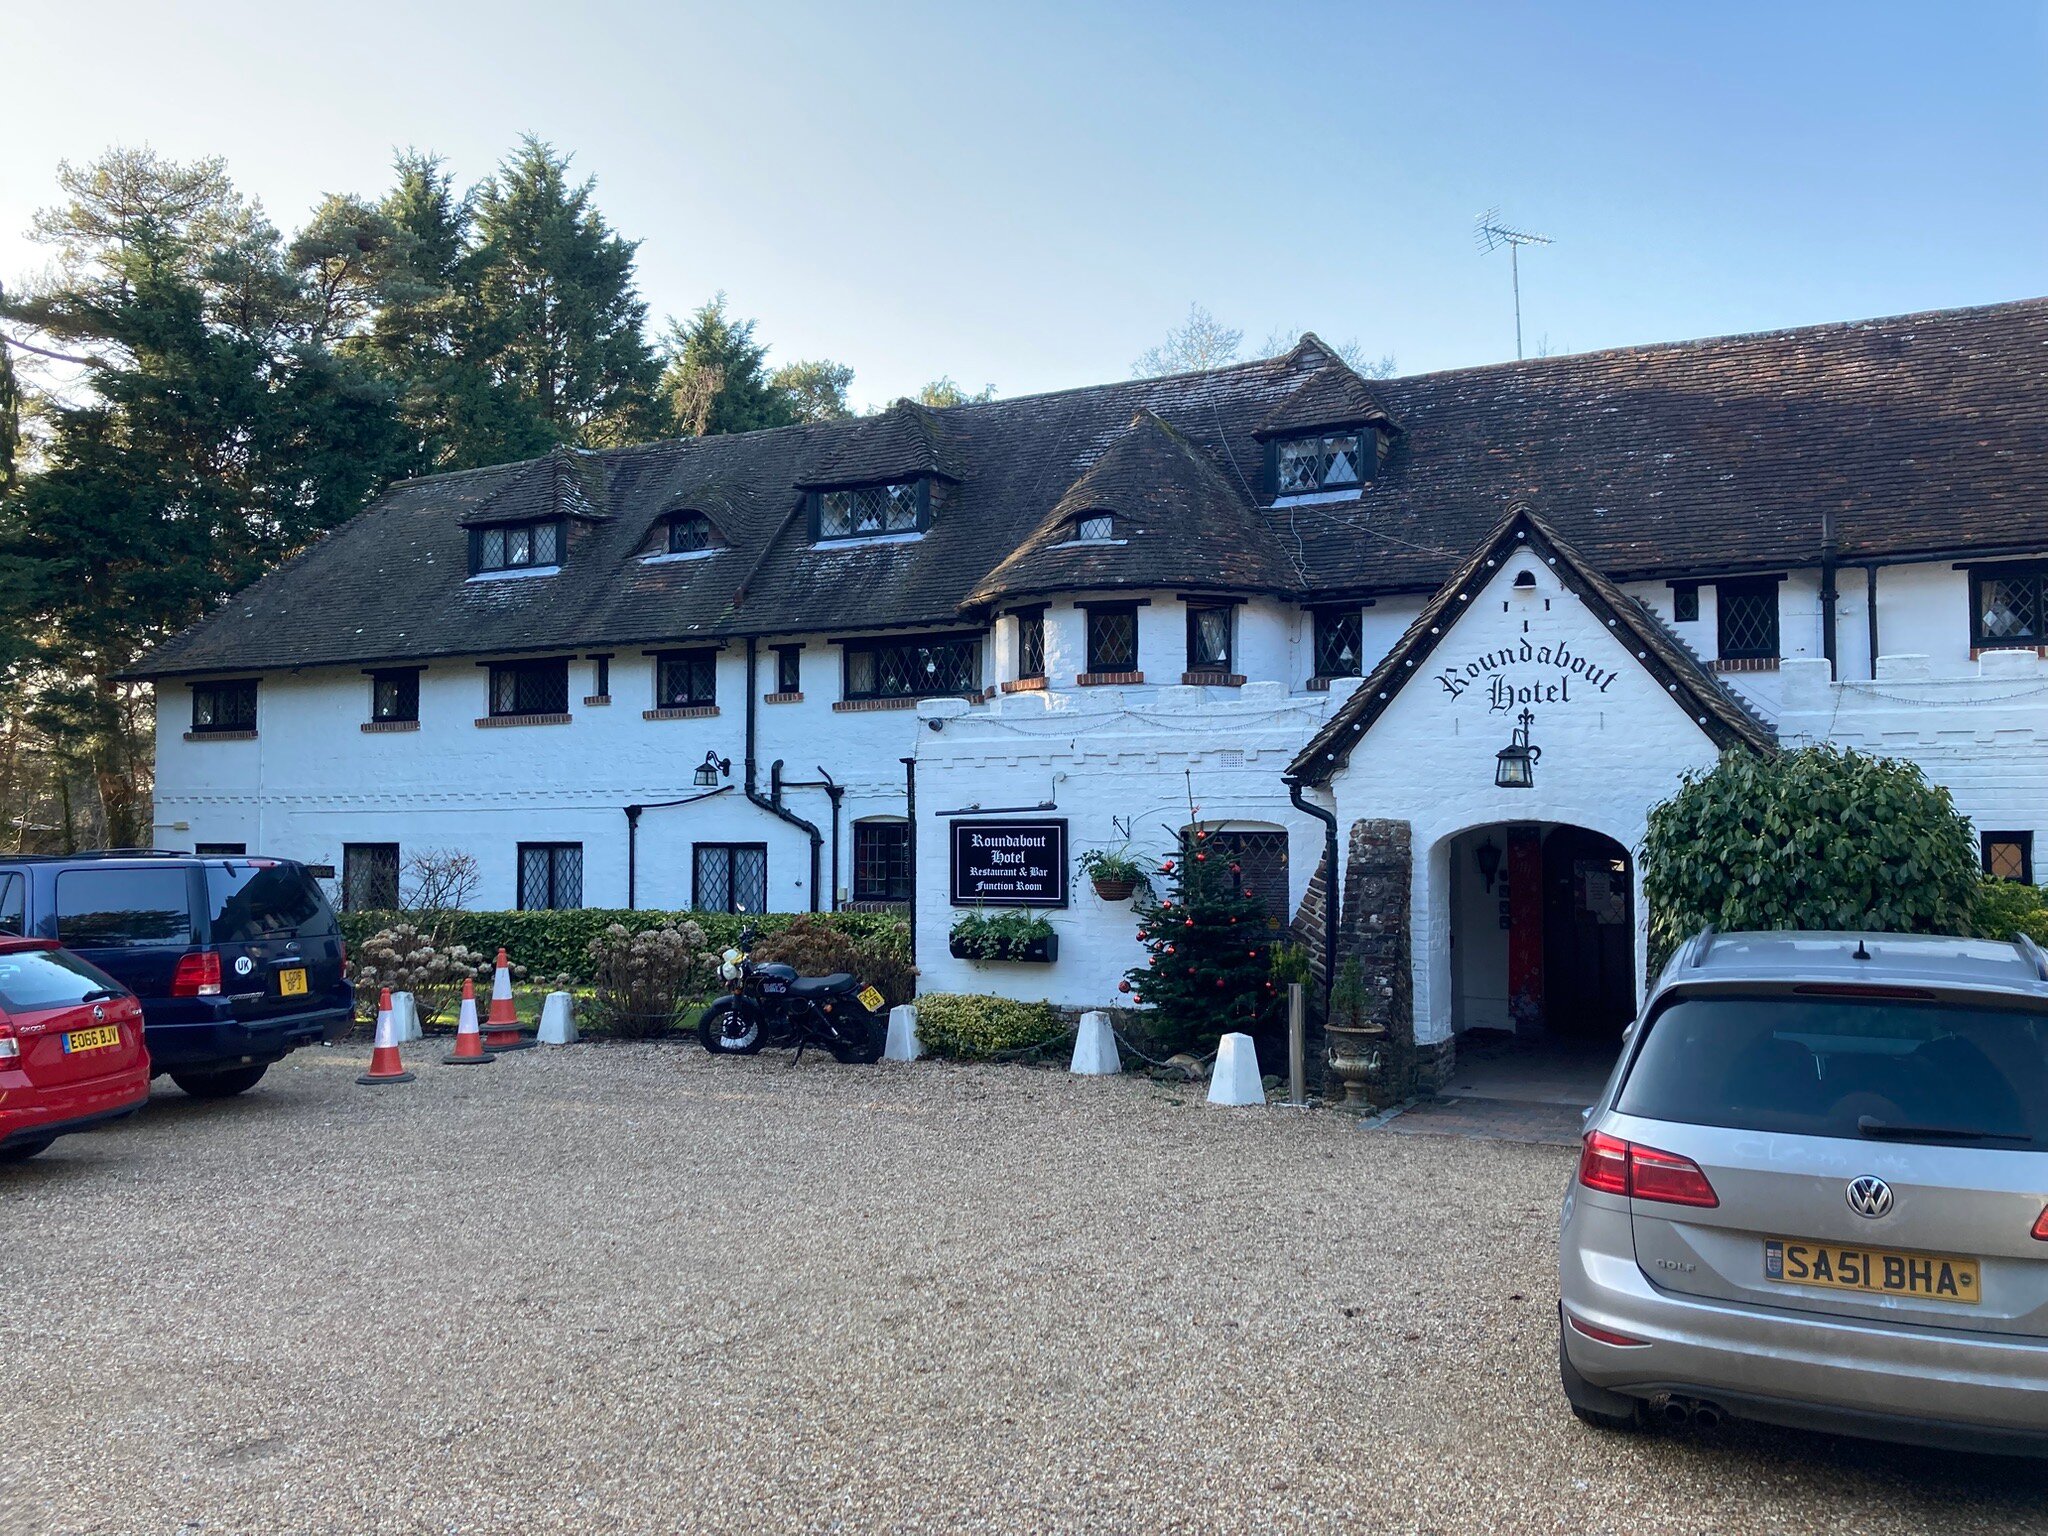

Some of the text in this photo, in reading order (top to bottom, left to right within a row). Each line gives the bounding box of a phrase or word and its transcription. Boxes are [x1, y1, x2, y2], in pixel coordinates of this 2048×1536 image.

[1434, 638, 1618, 702] Roundabout
[1486, 673, 1571, 716] Hotel
[971, 833, 1046, 848] Roundabout
[990, 849, 1026, 866] Hotel
[969, 866, 1048, 878] Restaurant & Bar
[974, 881, 1042, 892] Function Room
[237, 959, 250, 972] UK
[71, 1028, 117, 1049] EO66 BJV
[1656, 1258, 1696, 1273] GOLF
[1787, 1246, 1959, 1296] SA51 BHA
